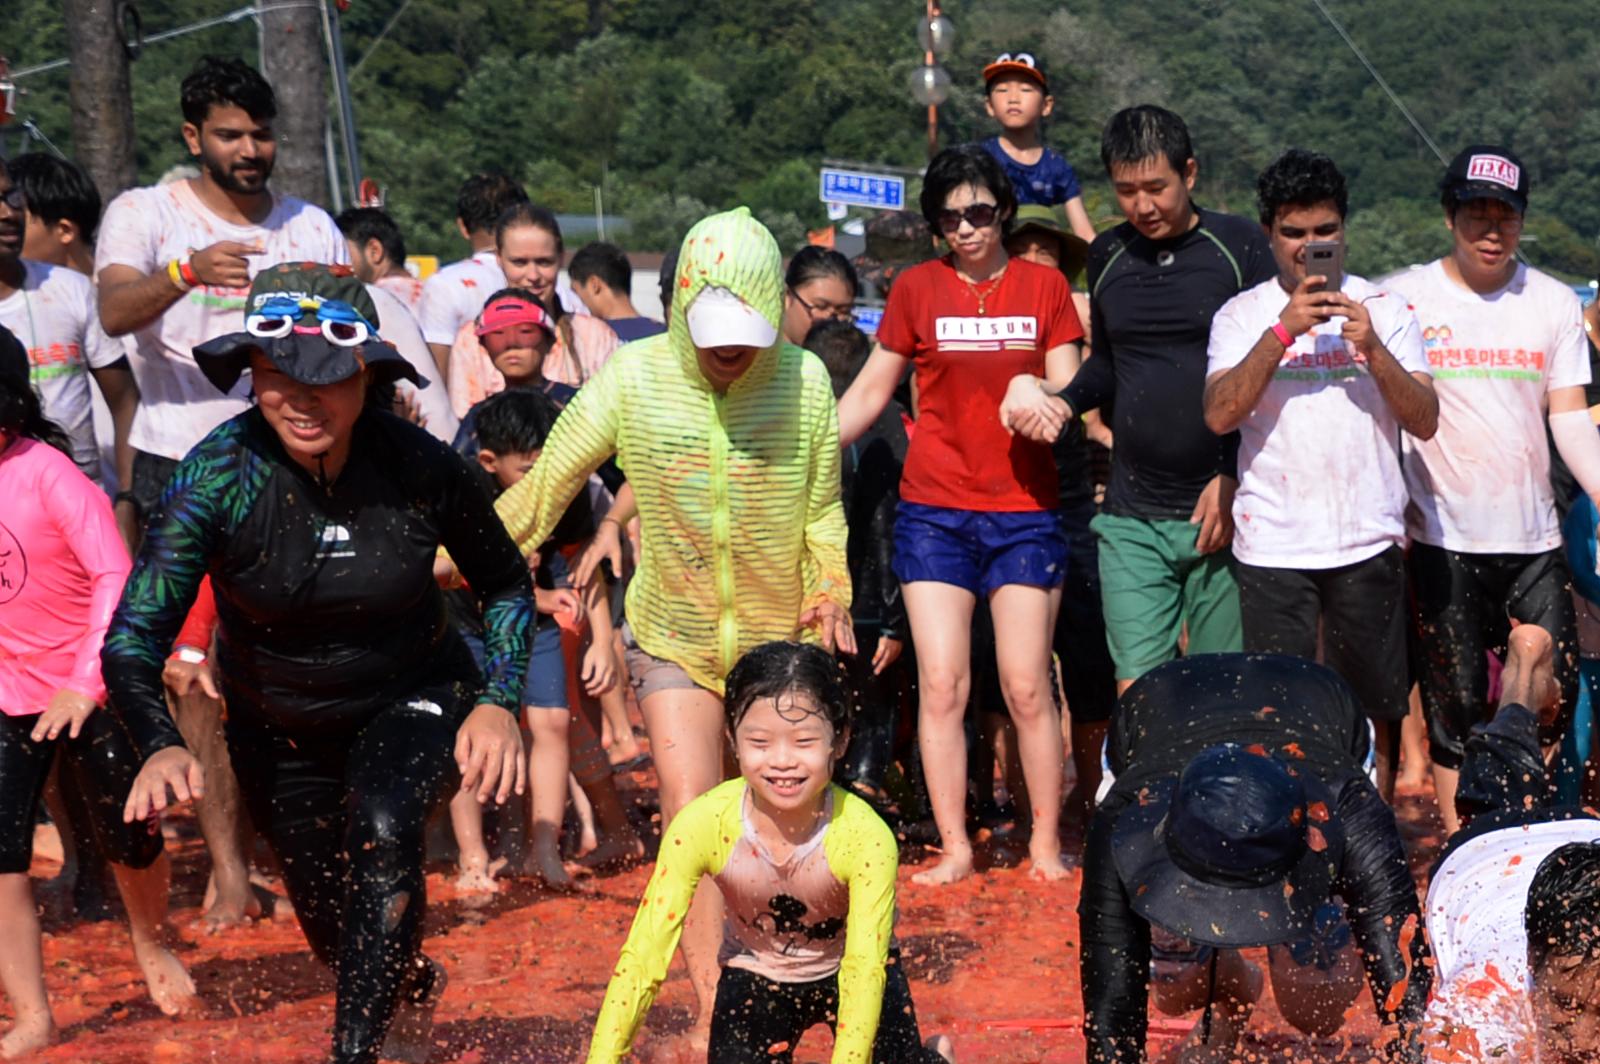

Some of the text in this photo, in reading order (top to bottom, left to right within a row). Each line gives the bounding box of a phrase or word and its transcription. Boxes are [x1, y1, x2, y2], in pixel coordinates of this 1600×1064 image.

[1471, 158, 1517, 185] TEXAS
[942, 321, 1033, 335] FITSUM
[1427, 348, 1545, 370] 화천토마토축제
